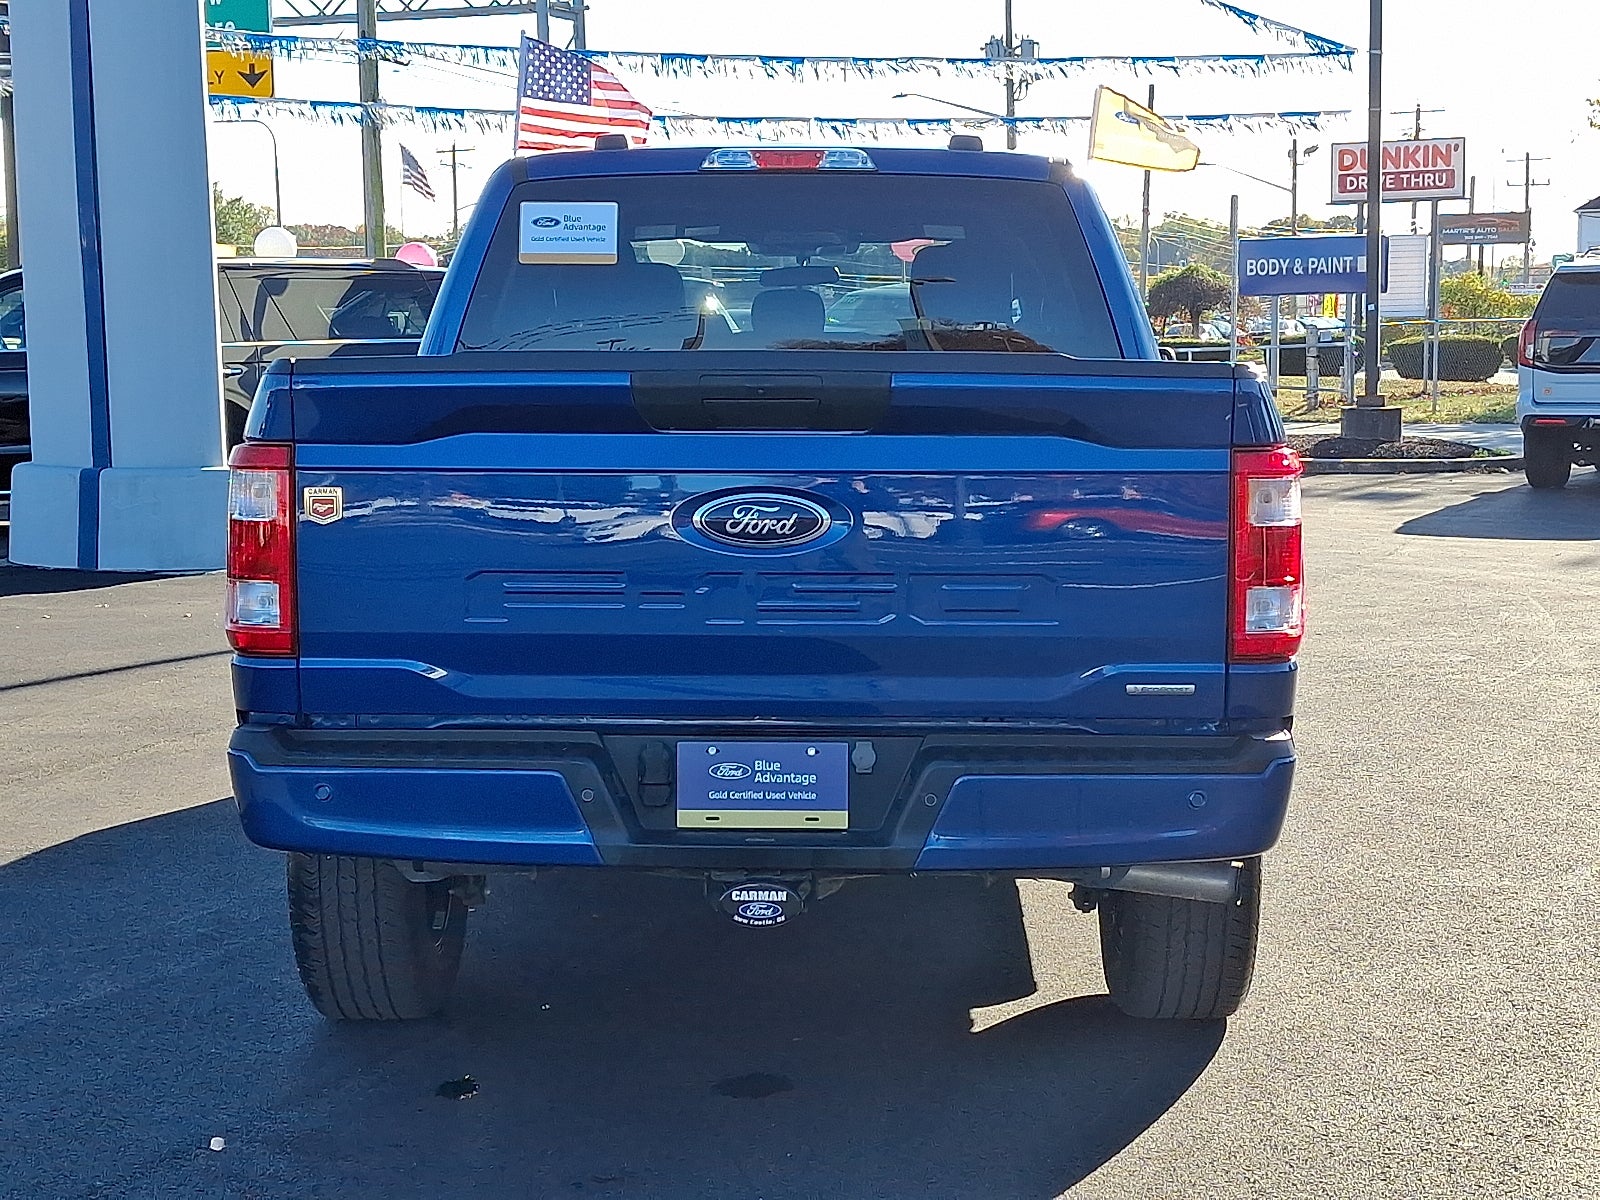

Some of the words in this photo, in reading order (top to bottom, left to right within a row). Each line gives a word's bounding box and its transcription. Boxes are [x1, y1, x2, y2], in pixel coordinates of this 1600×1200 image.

[1399, 172, 1447, 188] THRU
[536, 217, 556, 226] Ford
[563, 214, 582, 222] Blue
[563, 223, 607, 232] Advantage
[1245, 258, 1290, 276] BODY
[1292, 258, 1304, 275] &
[1308, 256, 1354, 275] PAINT
[725, 504, 799, 535] Ford
[716, 764, 744, 777] Ford
[754, 760, 781, 771] Blue
[754, 772, 818, 786] Advantage
[708, 790, 728, 800] Gold
[729, 790, 764, 800] Certified
[765, 790, 786, 800] Used
[787, 790, 818, 800] Vehicle
[731, 890, 788, 902] CARMAN
[746, 903, 774, 916] Ford
[733, 914, 749, 925] New
